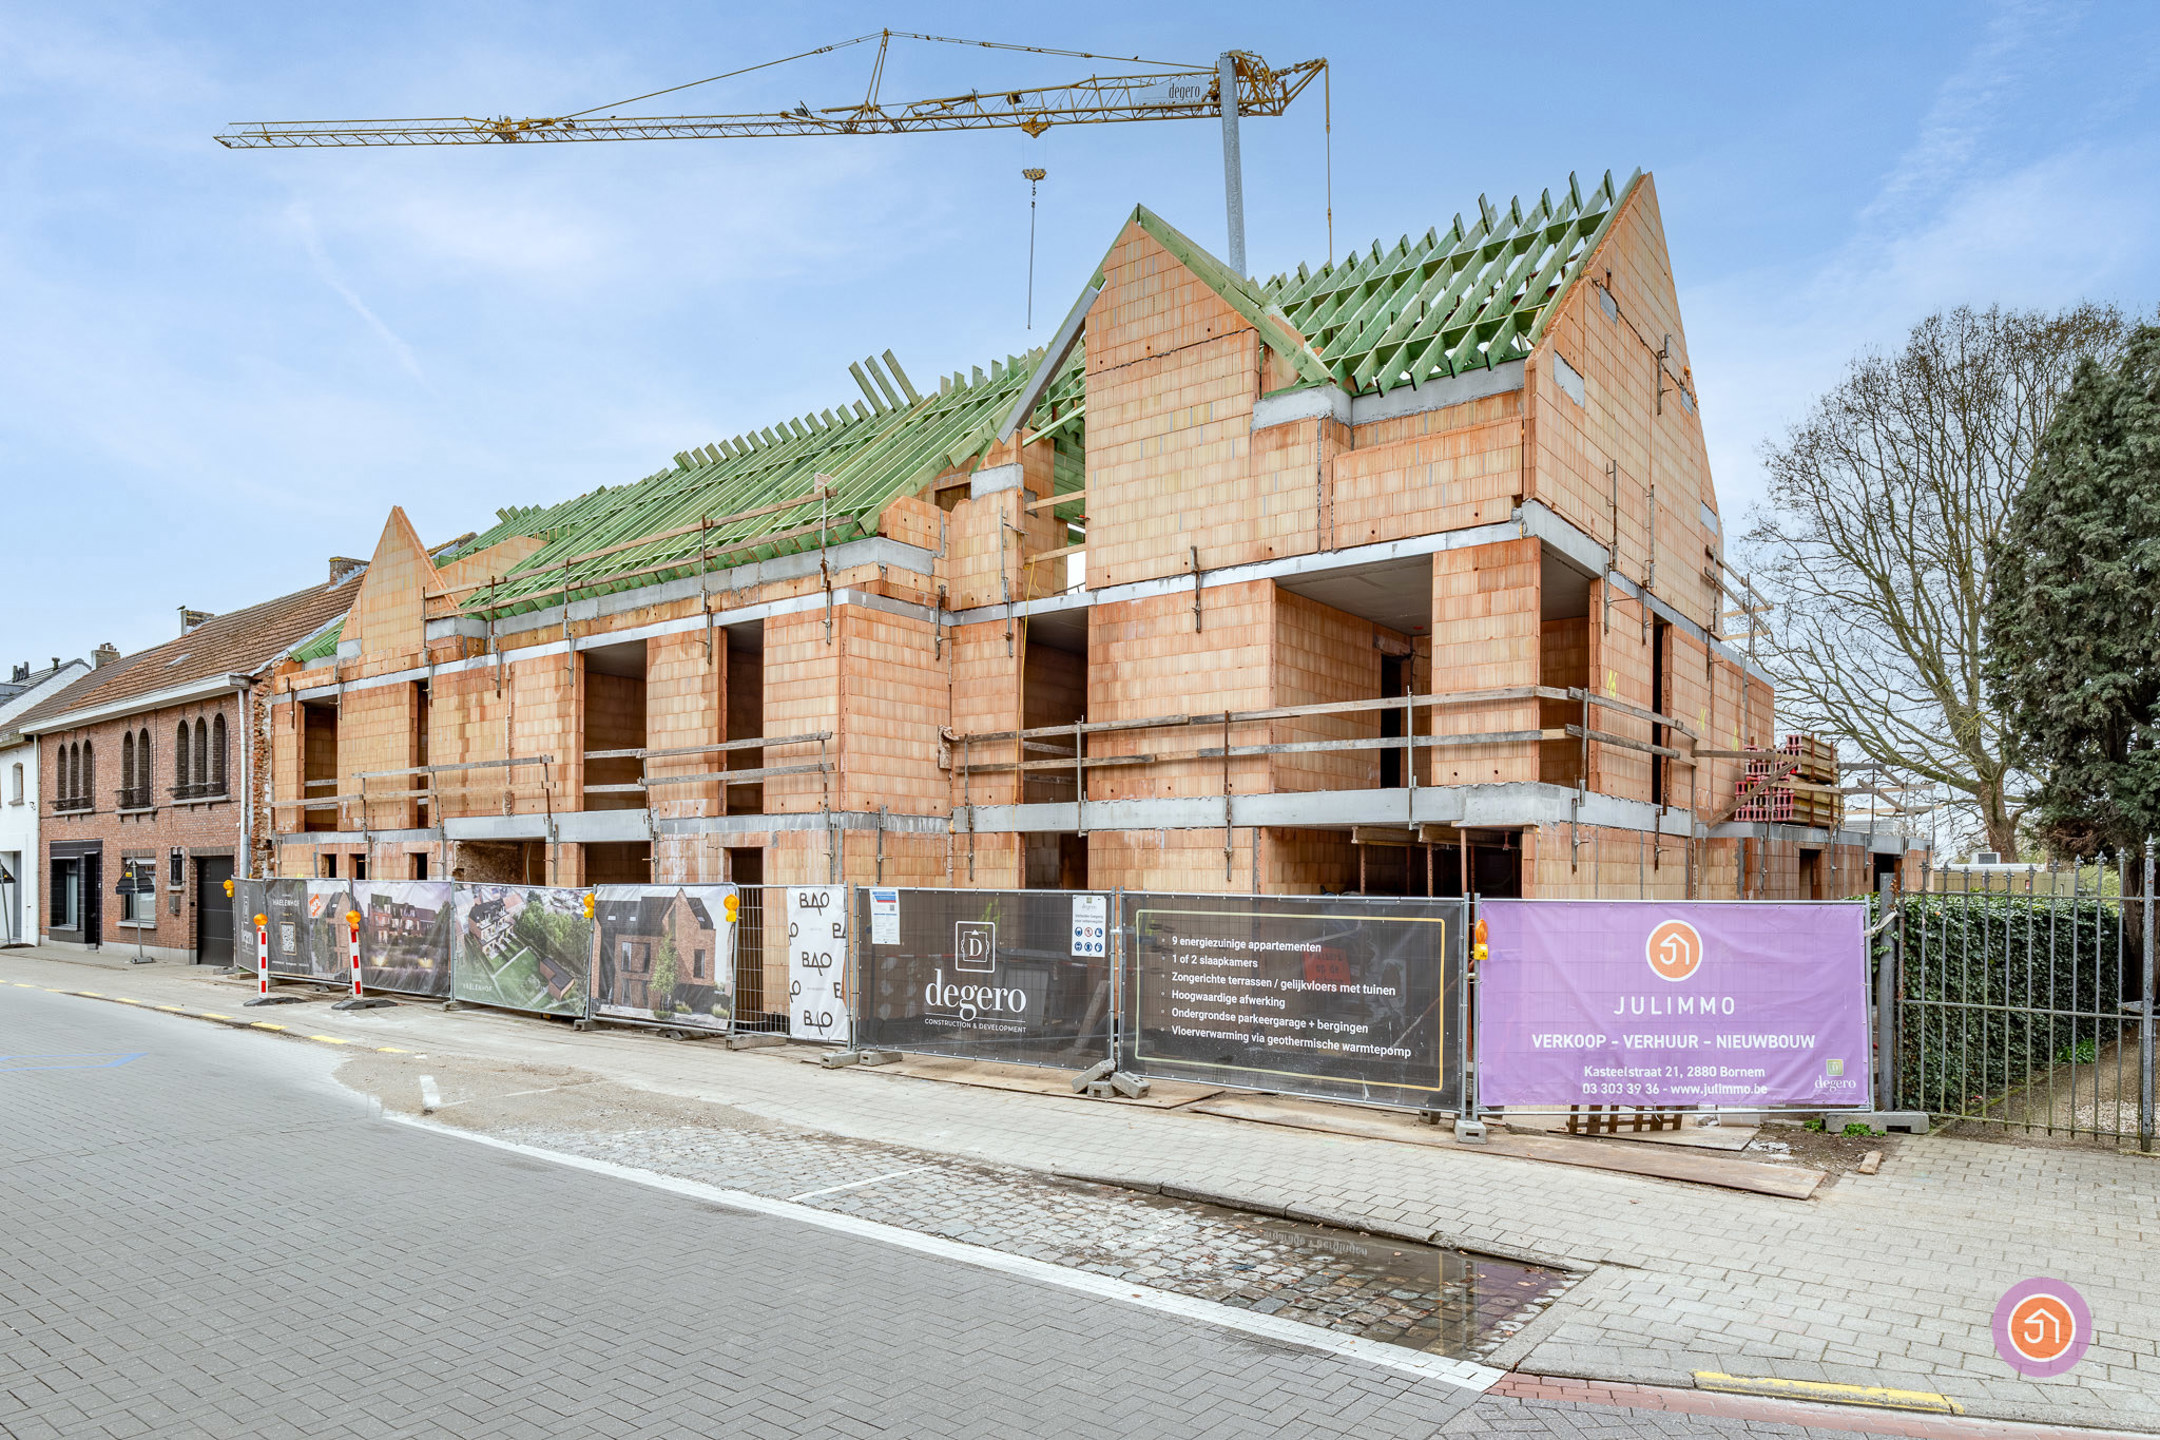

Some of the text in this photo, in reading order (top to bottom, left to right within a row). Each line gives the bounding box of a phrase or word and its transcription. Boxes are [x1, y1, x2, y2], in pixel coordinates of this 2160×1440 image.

[1169, 83, 1200, 100] degero
[799, 891, 830, 916] BAO
[968, 938, 983, 957] D
[1172, 936, 1322, 953] 9 energiezuinige appartementen
[801, 951, 832, 976] BAO
[1172, 954, 1258, 968] 1 of 2 slaapkamers
[1172, 972, 1227, 984] Zongerichte
[1228, 976, 1272, 987] terrassen
[1280, 979, 1337, 992] gelijkvloers
[1340, 983, 1360, 994] met
[1362, 984, 1396, 996] tuinen
[925, 968, 1027, 1021] degero
[1172, 990, 1286, 1009] Hoogwaardige afwerking
[1613, 996, 1735, 1015] JULIMMO
[924, 1018, 971, 1029] CONSTRUCTION
[978, 1023, 1027, 1033] DEVELOPMENT
[1172, 1007, 1236, 1022] Ondergrondse
[1238, 1014, 1307, 1030] parkeergarage
[1317, 1019, 1369, 1034] bergingen
[1172, 1025, 1412, 1059] Vloerverwarming via geothermische warmtepomp
[1532, 1034, 1607, 1049] VERKOOP
[1623, 1034, 1699, 1049] VERHUUR
[1716, 1034, 1816, 1049] NIEUWBOUW
[1584, 1065, 1766, 1079] Kasteelstraat 21, 2880 Bornem
[1582, 1083, 1598, 1095] 03
[1601, 1083, 1623, 1095] 303
[1626, 1083, 1642, 1095] 39
[1645, 1083, 1660, 1095] 36
[1670, 1083, 1768, 1097] www.julimmo.be
[1814, 1075, 1857, 1093] degero
